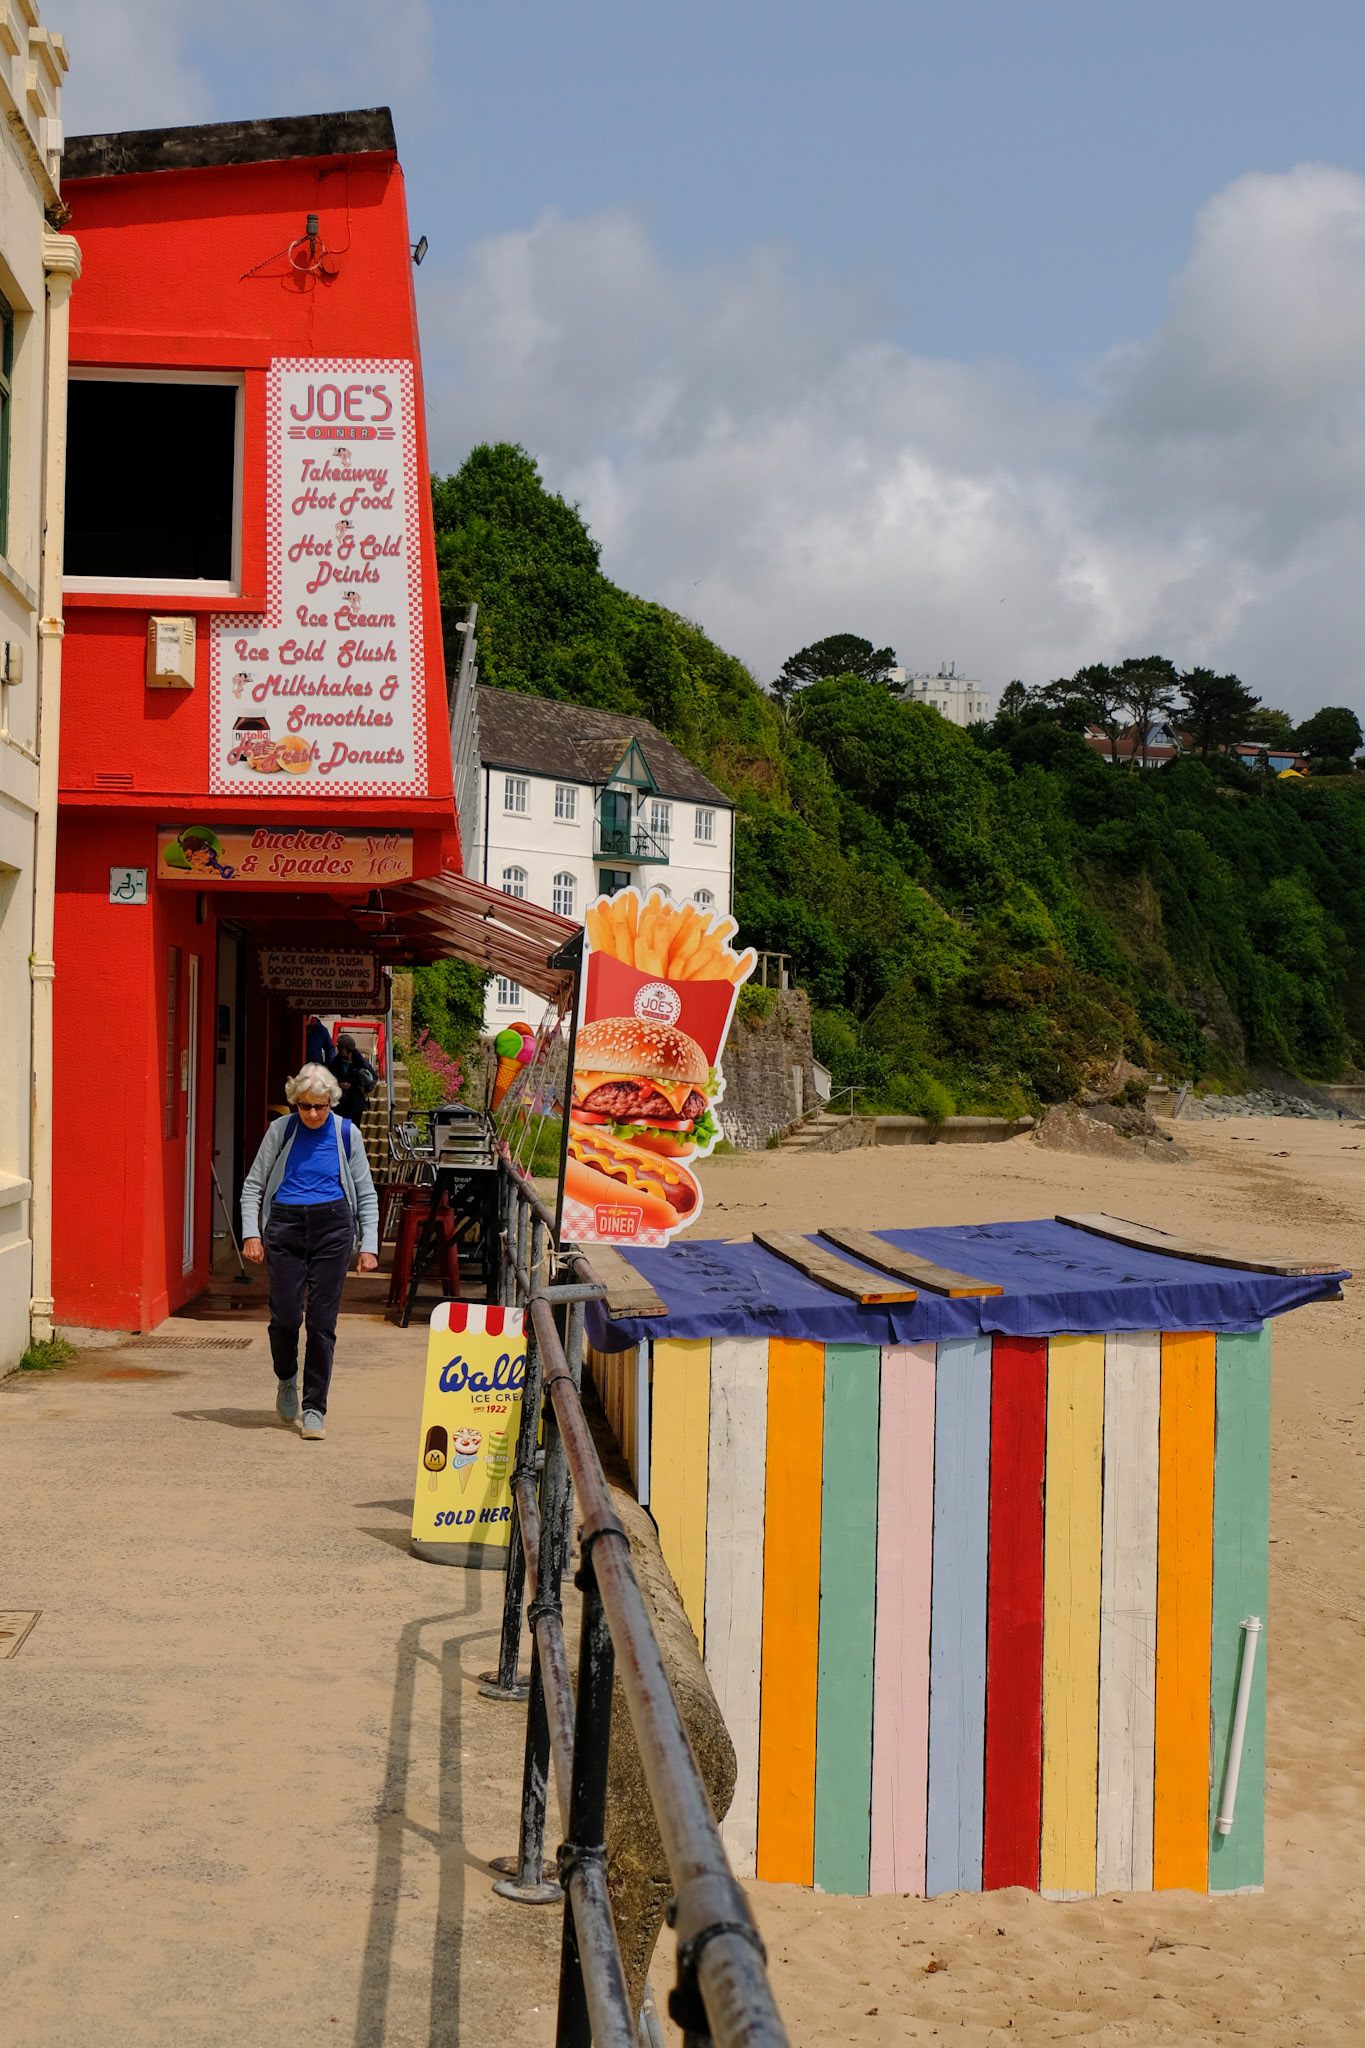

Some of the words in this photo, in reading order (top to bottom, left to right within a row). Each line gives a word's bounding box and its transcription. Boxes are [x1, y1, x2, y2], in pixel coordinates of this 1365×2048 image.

[290, 384, 393, 422] JOE'S
[313, 428, 369, 438] DINER
[300, 458, 388, 492] Takeaway
[291, 487, 337, 515] Hot
[339, 487, 395, 515] Food
[288, 534, 333, 562] Hot
[337, 534, 356, 561] &
[359, 534, 402, 560] Cold
[306, 561, 380, 593] Drinks
[296, 605, 328, 627] Ice
[334, 605, 396, 630] Cream
[234, 639, 269, 661] Ice
[279, 639, 327, 665] Cold
[337, 639, 397, 668] Slush
[251, 674, 373, 703] Milkshakes
[379, 674, 399, 701] &
[286, 704, 394, 733] Smoothies
[235, 730, 269, 740] nutella
[227, 736, 270, 766] Hot
[261, 739, 321, 774] Fresh
[318, 741, 405, 775] Donuts
[250, 828, 346, 851] Buckets
[362, 834, 400, 857] Sold
[240, 854, 259, 873] &
[268, 853, 355, 878] Spades
[362, 854, 407, 876] Here
[268, 966, 305, 976] DONUTS
[311, 967, 336, 977] COLD
[339, 968, 370, 978] DRINKS
[282, 955, 296, 964] ICE
[298, 955, 330, 965] CREAM
[336, 956, 363, 966] SLUSH
[284, 978, 313, 988] ORDER
[315, 979, 332, 989] THIS
[335, 980, 354, 990] WAY
[307, 999, 332, 1007] ORDER
[334, 999, 349, 1008] THIS
[351, 999, 368, 1008] WAY
[641, 998, 674, 1014] JOE'S
[600, 1216, 635, 1233] DINER
[439, 1353, 526, 1392] Wall
[471, 1394, 490, 1403] ICE
[486, 1405, 507, 1414] 1922
[434, 1509, 476, 1527] SOLD
